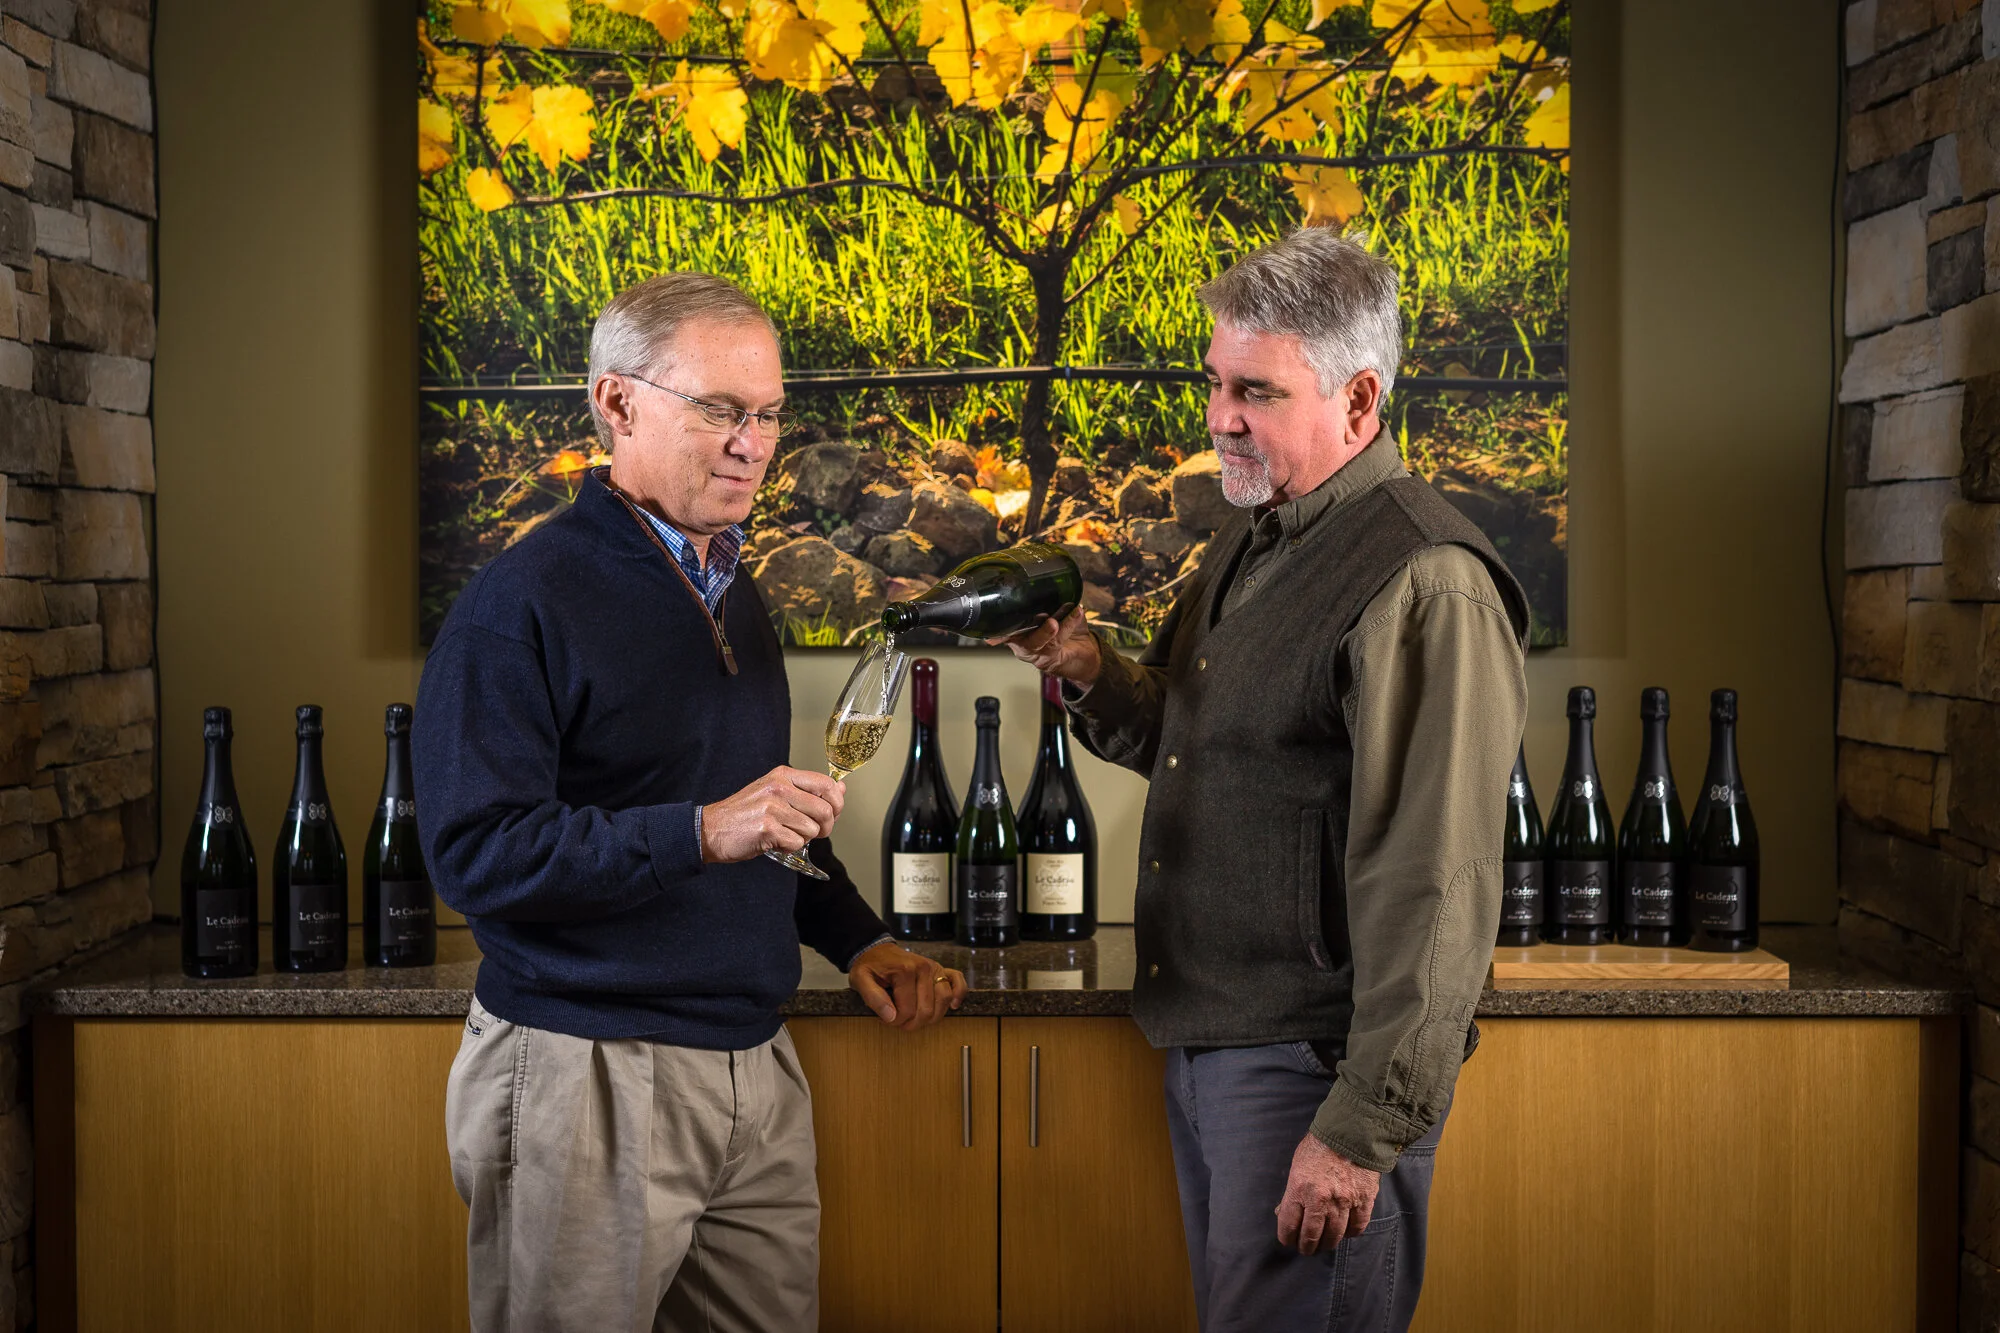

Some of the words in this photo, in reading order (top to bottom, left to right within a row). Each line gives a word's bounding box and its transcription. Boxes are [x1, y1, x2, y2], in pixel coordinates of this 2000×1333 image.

[912, 875, 941, 883] Cadeau
[1560, 886, 1570, 895] Le
[1572, 886, 1602, 896] Cadeau
[1631, 887, 1641, 896] Le
[1643, 887, 1673, 897] Cadeau
[1695, 891, 1704, 900] Le
[1706, 892, 1738, 902] Cadeau
[299, 912, 311, 921] Le
[389, 907, 401, 916] Le
[206, 916, 218, 926] Le
